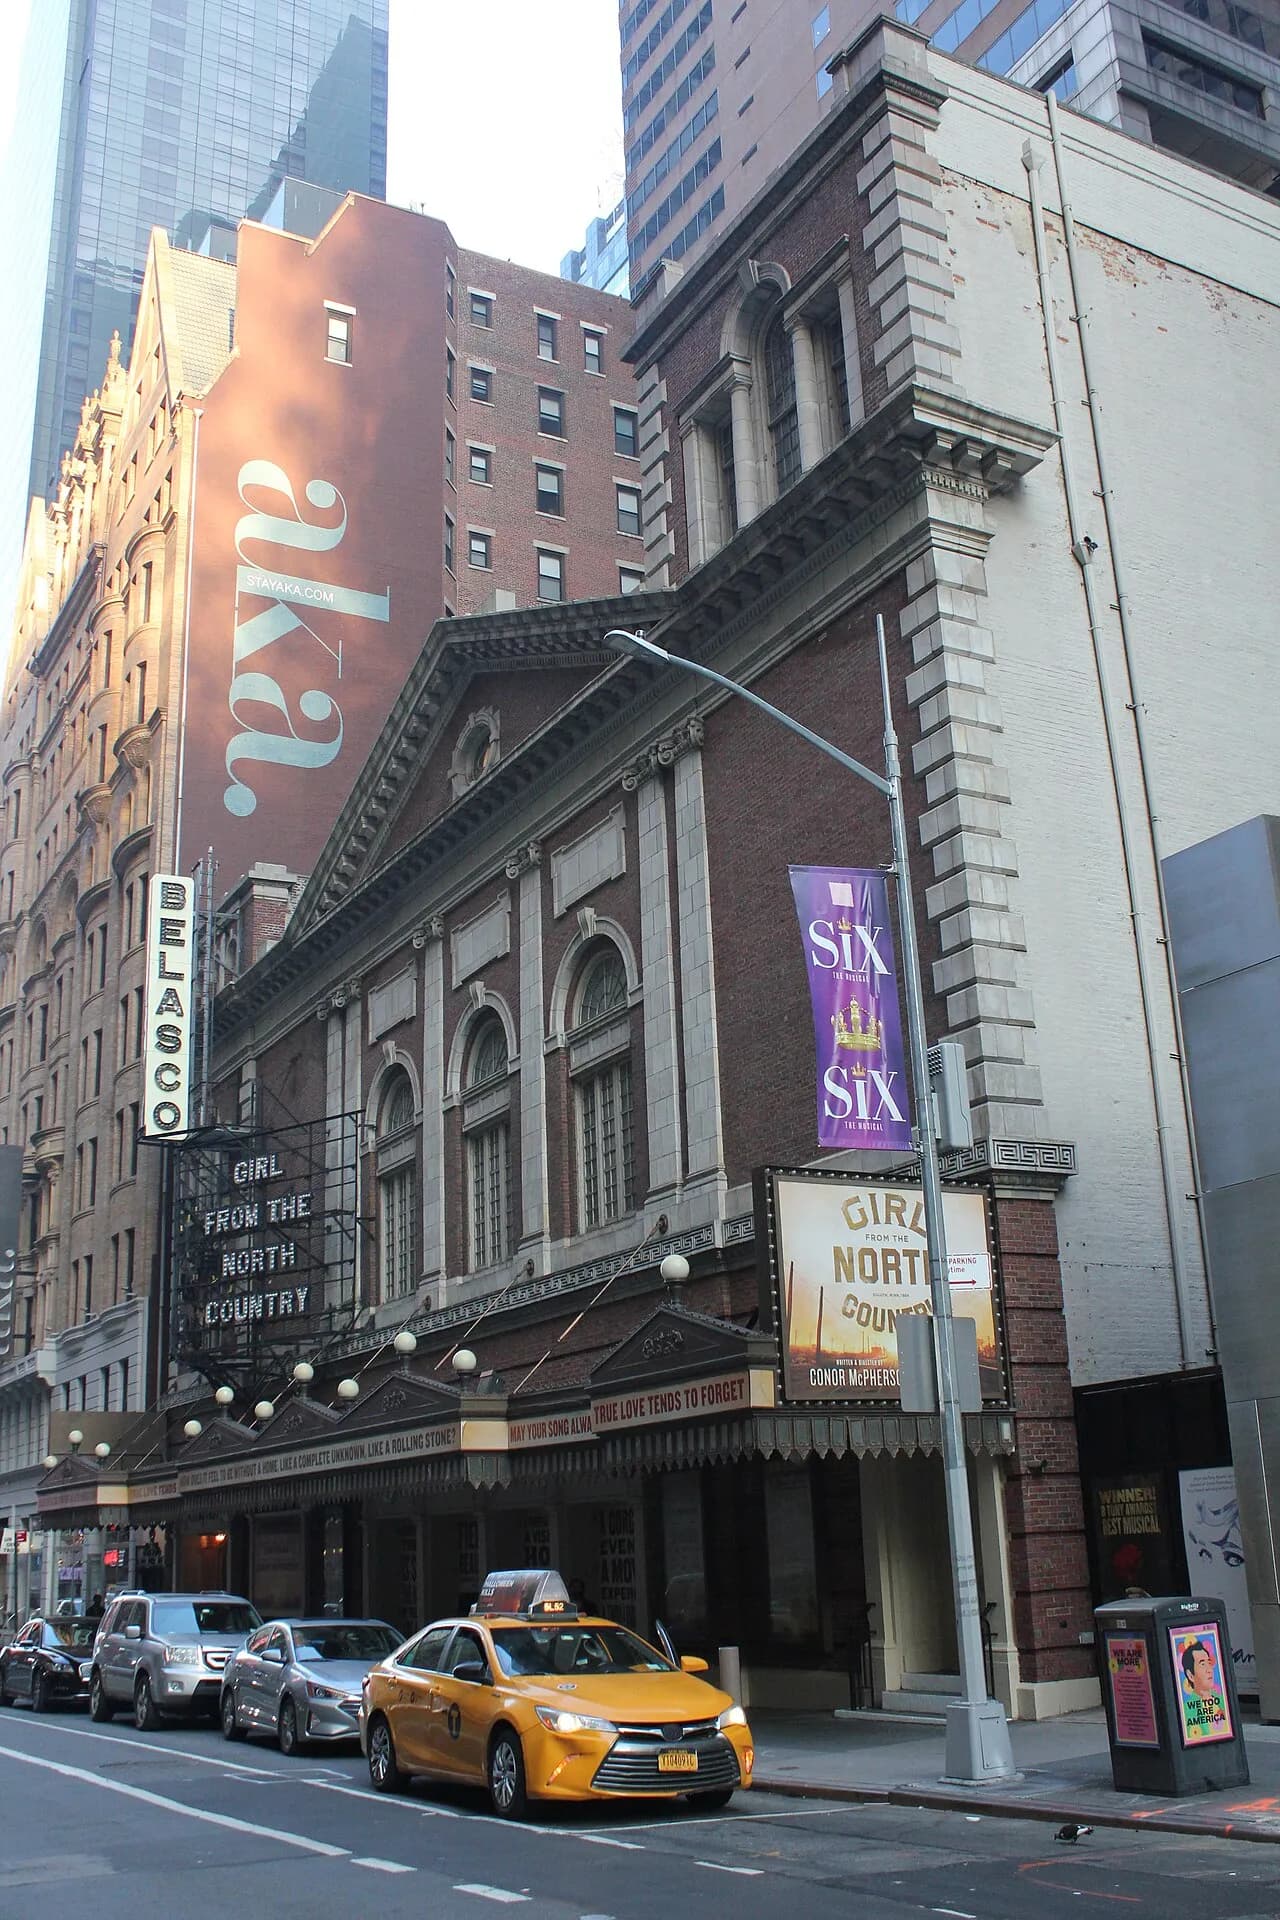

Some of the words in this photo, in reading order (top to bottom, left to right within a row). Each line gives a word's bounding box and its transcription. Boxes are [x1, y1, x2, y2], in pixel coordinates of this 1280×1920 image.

[246, 574, 335, 603] STAYAKA.COM
[153, 881, 188, 1131] BELASCO
[845, 1121, 856, 1129] THE
[233, 1154, 283, 1184] GIRL
[204, 1203, 259, 1236] FROM
[266, 1193, 311, 1223] THE
[841, 1192, 928, 1239] GIRL
[865, 1233, 890, 1242] FROM
[893, 1235, 909, 1243] THE
[222, 1242, 296, 1277] NORTH
[948, 1257, 977, 1265] PARKING
[205, 1287, 309, 1324] COUNTRY
[809, 1368, 846, 1386] CONOR
[593, 1402, 619, 1425] TRUE
[620, 1397, 646, 1421] LOVE
[648, 1390, 682, 1415] TENDS
[684, 1388, 698, 1409] TO
[701, 1378, 746, 1406] FORGET
[510, 1426, 527, 1442] MAY
[527, 1422, 548, 1440] YOUR
[548, 1418, 570, 1437] SONG
[233, 1463, 256, 1479] WITHOUT
[280, 1456, 292, 1472] LIKE
[298, 1449, 330, 1468] COMPLETE
[367, 1440, 384, 1457] LIKE
[385, 1439, 390, 1456] A
[391, 1433, 424, 1454] ROLLING
[425, 1427, 456, 1448] STONE?
[1099, 1487, 1157, 1504] WINNER!
[1107, 1504, 1124, 1517] TONY
[1102, 1517, 1122, 1536] BEST
[1123, 1515, 1161, 1535] MUSICAL
[1112, 1649, 1125, 1658] WE
[1126, 1648, 1143, 1658] ARE
[1117, 1657, 1140, 1666] MORE
[1187, 1699, 1201, 1710] WE
[1202, 1696, 1221, 1707] TOO
[1196, 1706, 1214, 1717] ARE
[1186, 1713, 1226, 1727] AMERICA
